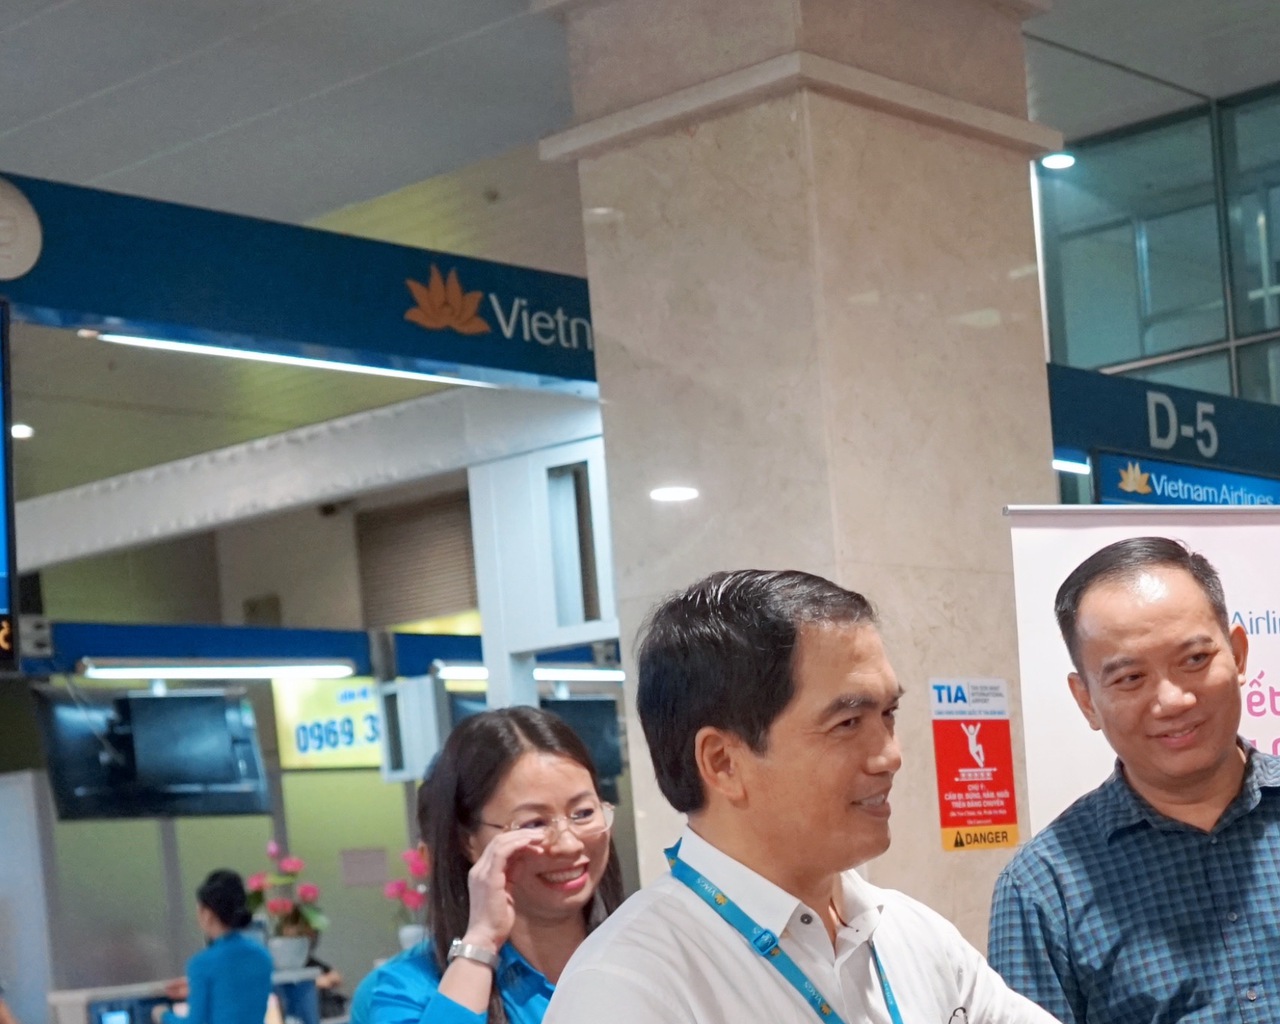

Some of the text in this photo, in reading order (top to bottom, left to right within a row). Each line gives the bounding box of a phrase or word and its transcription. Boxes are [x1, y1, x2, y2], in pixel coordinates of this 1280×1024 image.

[1147, 391, 1219, 459] D-5
[1151, 474, 1274, 504] Vietnam Airlines
[932, 684, 968, 703] TIA
[295, 717, 355, 753] 0969
[965, 831, 1008, 845] DANGER
